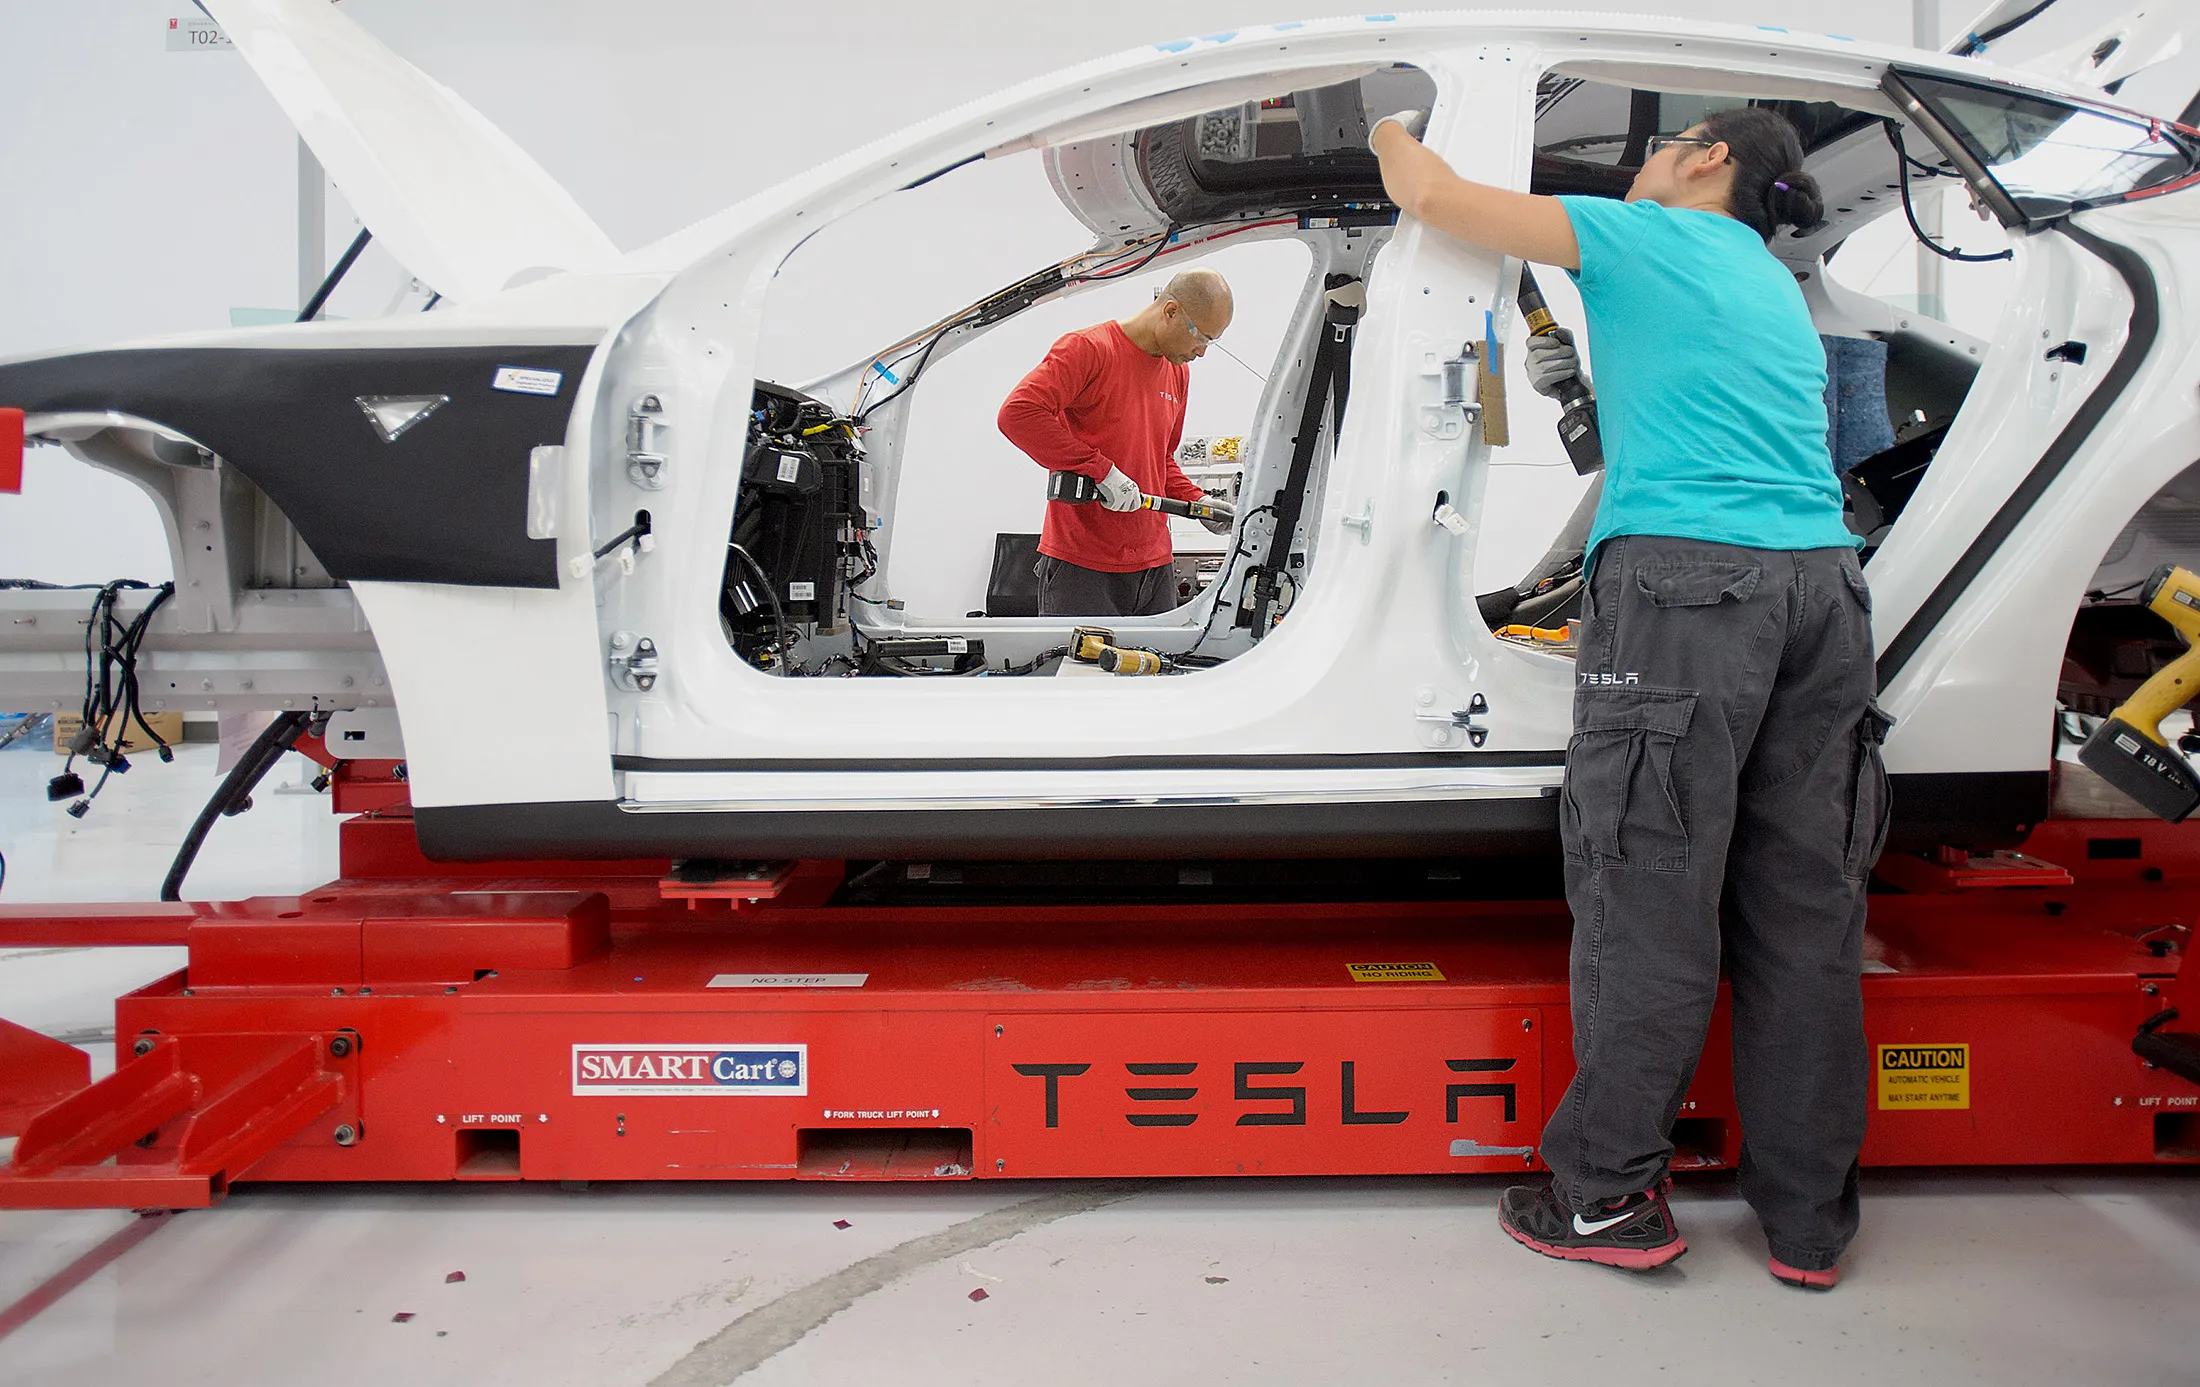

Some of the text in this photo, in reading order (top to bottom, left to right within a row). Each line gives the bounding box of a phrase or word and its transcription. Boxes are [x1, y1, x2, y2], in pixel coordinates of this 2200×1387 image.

[1580, 672, 1639, 685] TESLA
[2143, 754, 2167, 772] 18 V
[1885, 1051, 1963, 1067] CAUTION
[581, 1055, 709, 1079] SMART
[1888, 1075, 1960, 1084] AUTOMATIC VEHICLE
[1011, 1059, 1518, 1129] TESLA
[1888, 1094, 1960, 1102] MAY START ANYTIME
[2167, 1097, 2198, 1105] POINT
[462, 1114, 521, 1123] LIFT POINT
[833, 1111, 855, 1119] FORK
[857, 1111, 884, 1119] TRUCK
[906, 1110, 930, 1118] POINT
